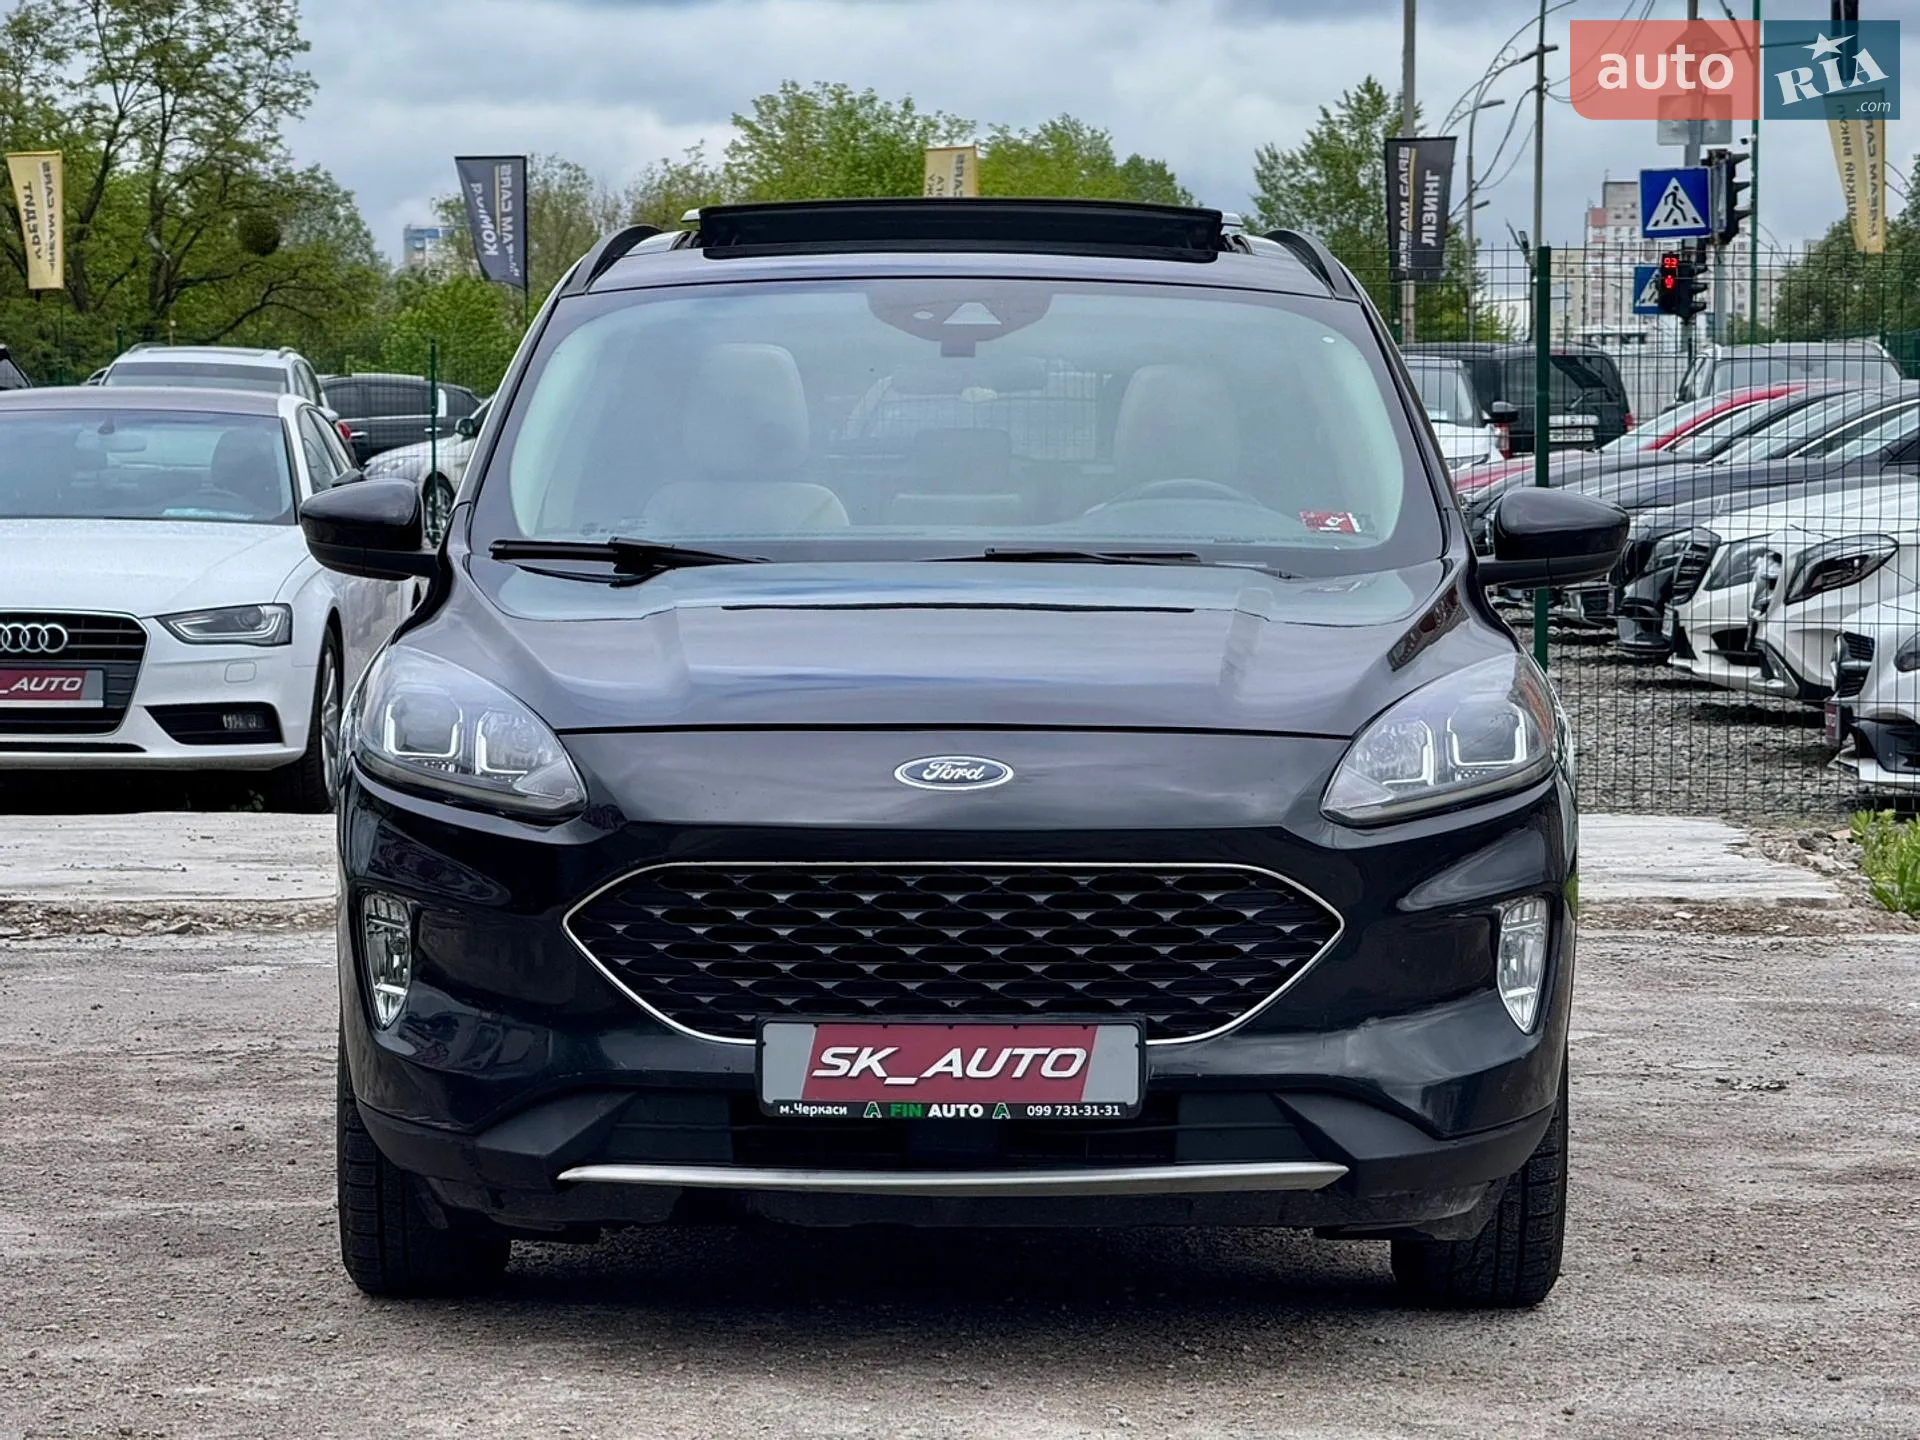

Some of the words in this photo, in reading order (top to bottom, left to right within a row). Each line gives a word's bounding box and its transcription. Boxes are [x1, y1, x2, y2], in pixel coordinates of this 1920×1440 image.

[1398, 146, 1411, 197] CARS
[1421, 169, 1441, 247] ЛІЗИНГ
[1398, 201, 1410, 272] DREAM
[922, 761, 986, 780] Ford
[811, 1046, 1087, 1085] SK_AUTO
[779, 1103, 848, 1117] м.Черкаси
[890, 1104, 923, 1117] FIN
[928, 1104, 984, 1117] AUTO
[1026, 1105, 1051, 1116] 099
[1056, 1105, 1121, 1116] 731-31-31
